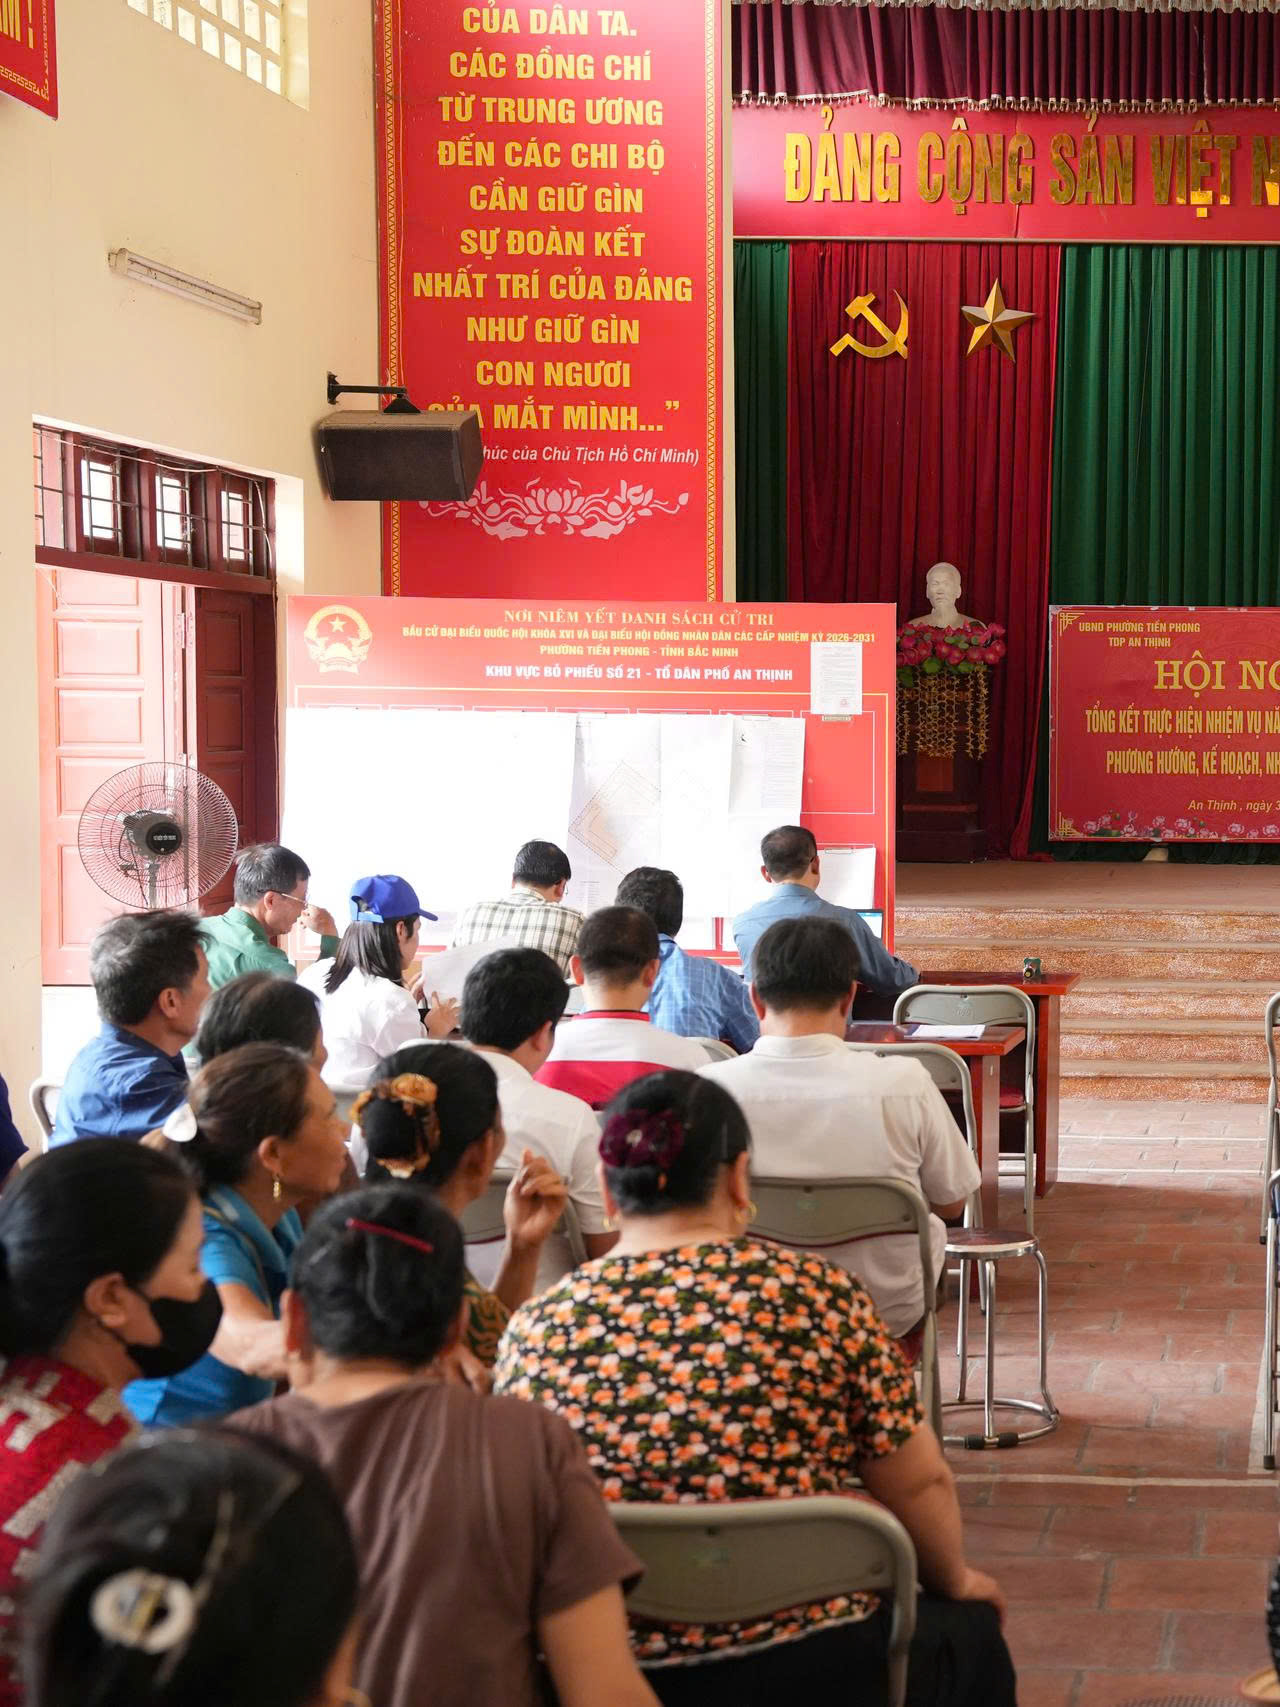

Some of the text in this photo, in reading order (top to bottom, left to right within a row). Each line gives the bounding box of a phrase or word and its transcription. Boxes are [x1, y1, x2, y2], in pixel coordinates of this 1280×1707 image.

[462, 0, 637, 37] CỦA DÂN TA.
[449, 45, 651, 80] CÁC ĐỒNG CHÍ
[438, 91, 663, 125] TỪ TRUNG ƯƠNG
[438, 133, 665, 175] ĐẾN CÁC CHI BỘ
[784, 106, 901, 202] ĐẢNG
[918, 118, 1035, 214] CỘNG
[1050, 111, 1133, 205] SẢN
[1150, 119, 1240, 217] VIỆT
[470, 177, 643, 213] CẦN GIỮ GÌN
[460, 223, 645, 260] SỰ ĐOÀN KẾT
[413, 264, 692, 301] NHẤT TRÍ CỦA ĐẢNG
[467, 313, 639, 344] NHƯ GIỮ GÌN
[476, 360, 630, 387] CON NGƯƠI
[494, 396, 555, 430] MẮT
[512, 444, 699, 467] của Chủ Tịch Hồ Chí Minh)
[504, 607, 774, 625] NƠI NIÊM YẾT DANH SÁCH CỬ TRI
[1079, 620, 1200, 633] UBND PHƯỜNG PHONG
[512, 626, 528, 640] HỘI
[560, 629, 574, 639] XVI
[577, 628, 589, 639] VÀ
[635, 630, 651, 642] HỘI
[682, 630, 709, 641] NHÂN
[712, 630, 731, 641] DÂN
[734, 630, 753, 641] CÁC
[756, 630, 775, 641] CẤP
[778, 631, 809, 643] NHIỆM
[826, 633, 875, 642] 2026-2031
[540, 643, 584, 655] PHƯỜNG
[613, 646, 650, 656] PHONG
[712, 647, 739, 657] NINH
[1108, 637, 1171, 649] TDP AN THỊNH
[486, 665, 512, 677] KHU
[516, 664, 540, 680] VỰC
[544, 663, 561, 677] BỎ
[565, 664, 603, 679] PHIẾU
[606, 664, 623, 679] SỐ
[627, 668, 641, 679] 21
[674, 666, 700, 679] DÂN
[704, 665, 730, 680] PHỐ
[733, 669, 752, 680] AN
[755, 669, 793, 683] THỊNH
[1154, 650, 1226, 698] HỘI
[1085, 700, 1116, 733] TỔNG
[1119, 702, 1140, 733] KẾT
[1143, 708, 1172, 739] THỰC
[1175, 705, 1202, 739] HIỆN
[1206, 705, 1244, 739] NHIỆM
[1247, 710, 1262, 739] VỤ
[1106, 748, 1153, 773] PHƯƠNG
[1157, 746, 1199, 777] HƯỚNG,
[1203, 744, 1218, 774] KẾ
[1220, 751, 1263, 780] HOẠCH,
[1188, 800, 1203, 810] An
[1246, 800, 1273, 813] ngày
